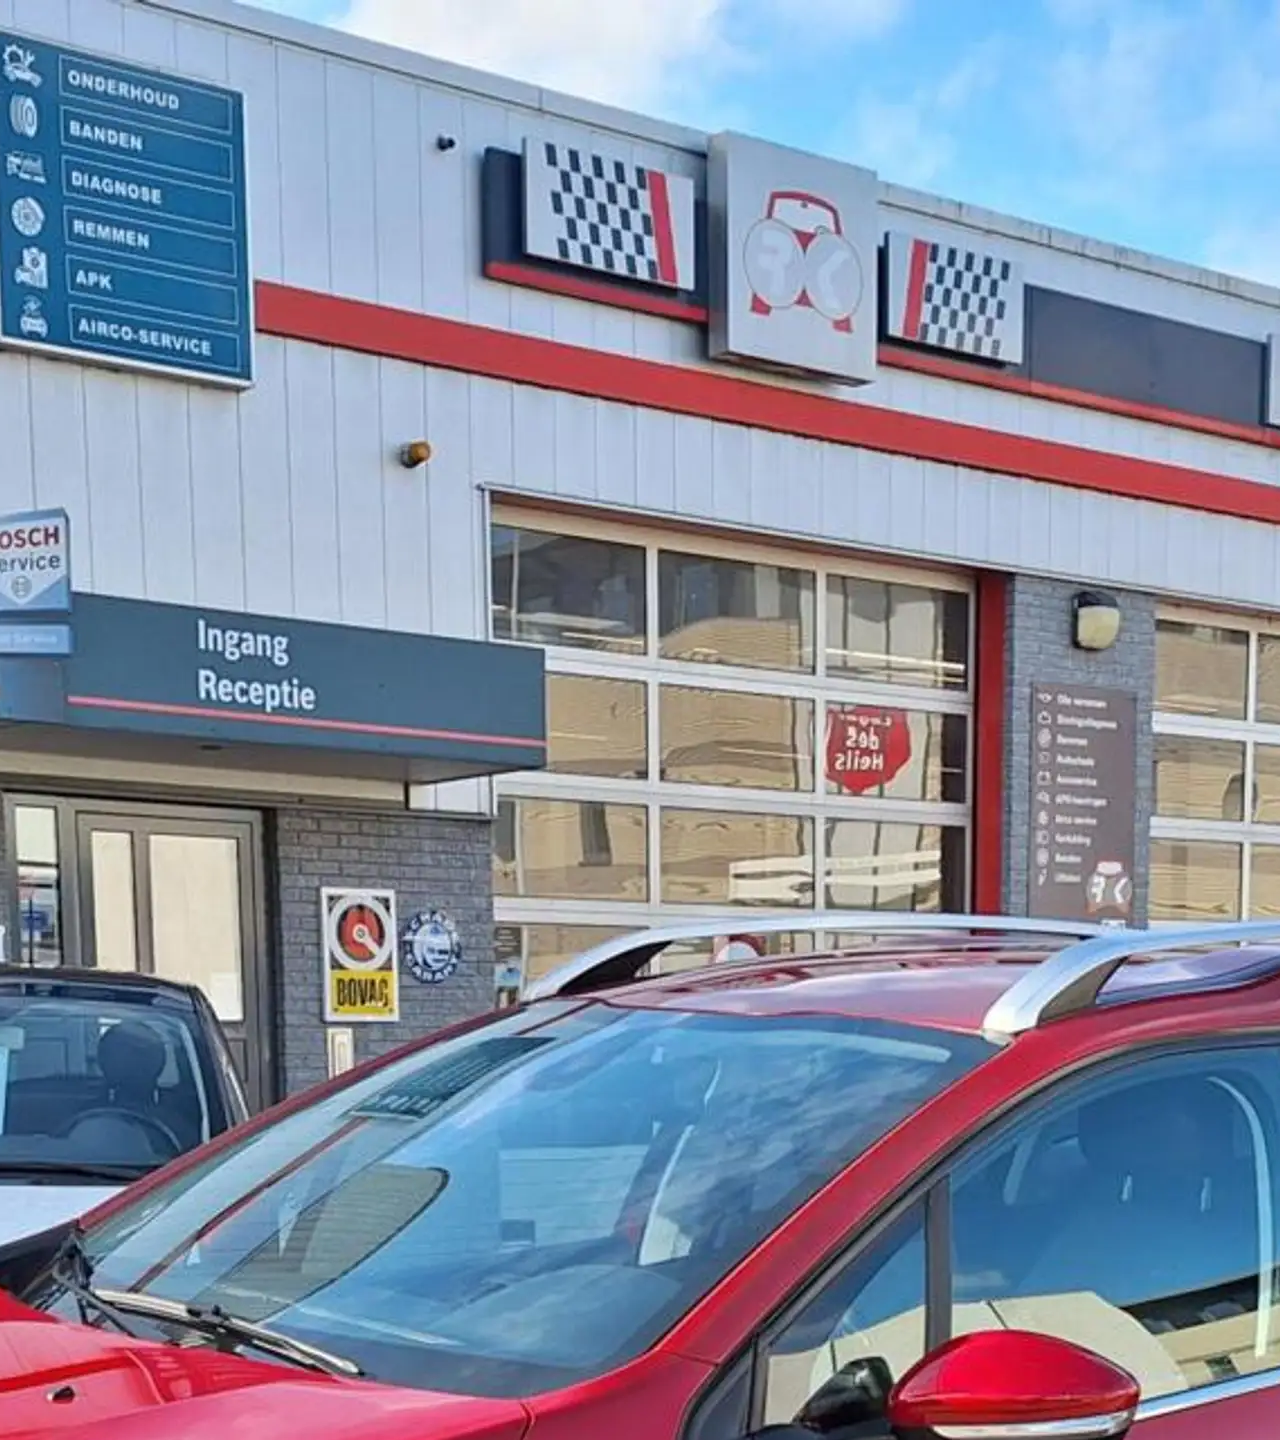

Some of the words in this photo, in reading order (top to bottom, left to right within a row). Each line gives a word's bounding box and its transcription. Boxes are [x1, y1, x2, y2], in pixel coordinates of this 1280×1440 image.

[67, 69, 180, 110] ONDERHOUD
[69, 120, 143, 151] BANDEN
[71, 170, 162, 205] DIAGNOSE
[73, 218, 150, 249] REMMEN
[75, 269, 112, 290] APK
[78, 318, 212, 357] AIRCO-SERVICE
[197, 618, 289, 666] Ingang
[198, 668, 317, 713] Receptie
[336, 977, 389, 1007] BOVAG
